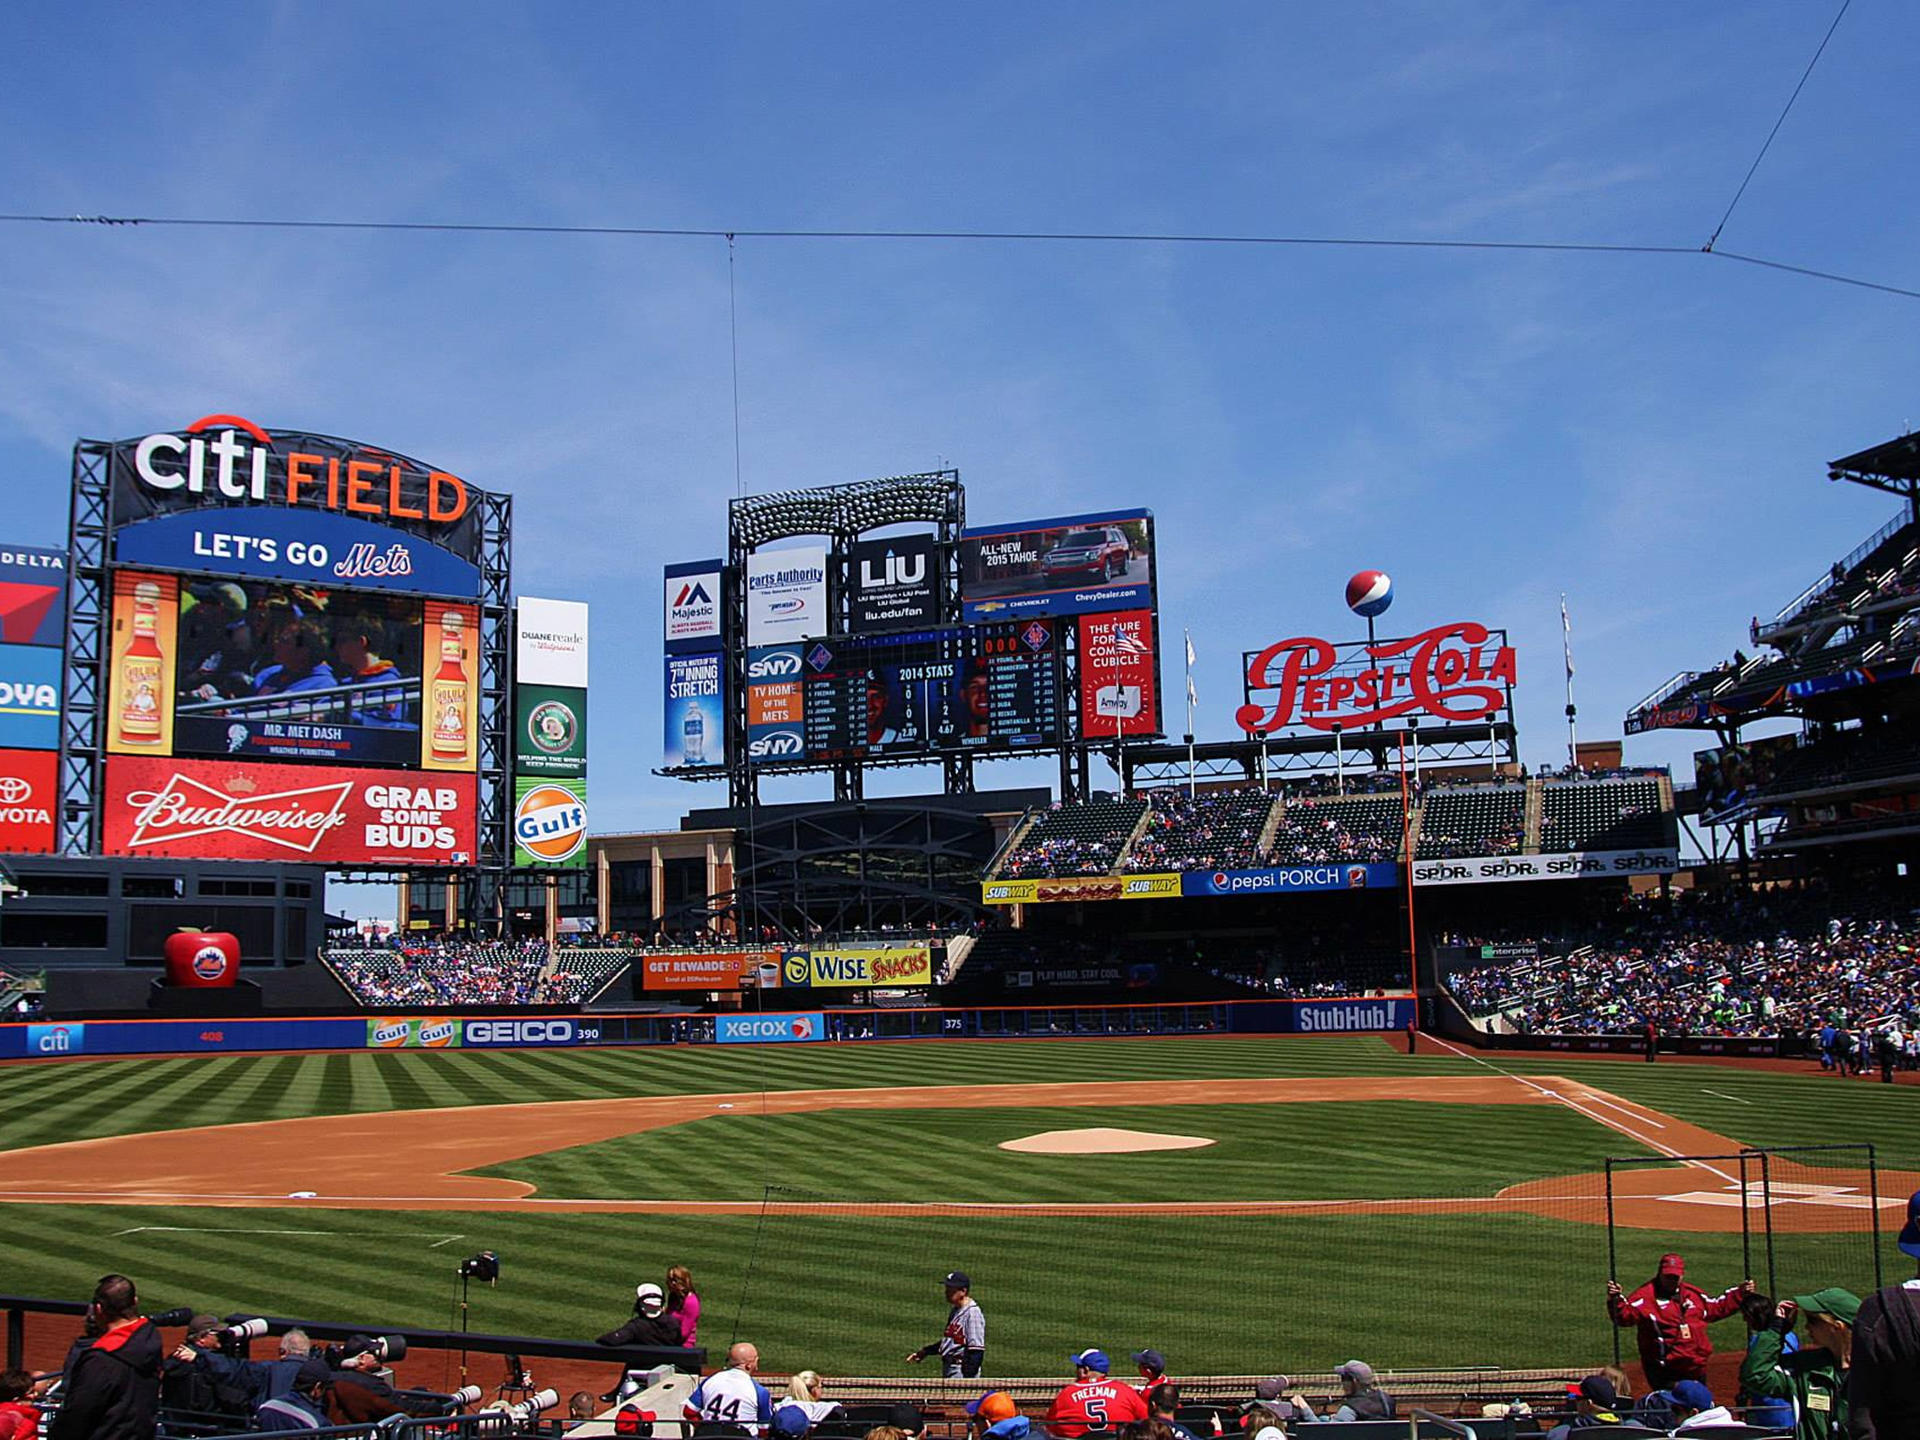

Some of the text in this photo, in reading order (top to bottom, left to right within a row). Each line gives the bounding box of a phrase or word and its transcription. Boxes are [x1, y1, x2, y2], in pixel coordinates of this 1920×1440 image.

[135, 429, 467, 522] citi FIELD
[194, 532, 413, 577] LET'S GO Mets
[981, 542, 1021, 556] ALL-NEW
[1, 552, 64, 569] DELTA
[987, 551, 1038, 566] 2015 TAHOE
[749, 567, 823, 588] Parts Authority
[869, 593, 897, 601] Brooklyn
[1075, 590, 1136, 602] ChevyDealer.com
[672, 606, 713, 619] Majestic
[865, 607, 923, 620] liu.edu/fan
[521, 631, 552, 641] DUANE
[1089, 624, 1110, 634] THE
[985, 638, 1016, 653] 0 0 0
[1093, 636, 1115, 645] FOR
[748, 656, 795, 677] SNY
[1093, 655, 1140, 667] CUBICLE
[686, 665, 718, 681] INNING
[900, 665, 953, 680] 2014 STATS
[670, 679, 718, 699] STRETCH
[754, 684, 798, 697] TV HOME
[905, 690, 912, 699] 0
[774, 698, 787, 706] THE
[943, 705, 948, 715] 2
[762, 710, 789, 722] METS
[906, 709, 912, 719] 0
[264, 724, 341, 740] MR. MET DASH
[939, 725, 954, 734] 4.67
[749, 737, 795, 756] SNY
[364, 785, 458, 811] GRAB
[127, 790, 347, 829] Budweiser
[380, 810, 442, 825] SOME
[518, 808, 581, 838] Gulf
[365, 825, 456, 849] BUDS
[1127, 877, 1178, 893] SUBWAY
[1232, 868, 1339, 890] pepsi PORCH
[986, 884, 1034, 899] SUBWAY
[649, 962, 670, 972] GET
[814, 951, 929, 984] WISE SNACKS
[1300, 1000, 1396, 1031] StubHub!
[466, 1021, 572, 1042] GEICO
[726, 1020, 787, 1037] xerox
[945, 1019, 962, 1029] 375
[40, 1030, 69, 1051] citi
[376, 1025, 408, 1041] Gulf
[420, 1025, 452, 1041] Gulf
[577, 1029, 599, 1039] 390
[1071, 1386, 1117, 1402] FREEMAN
[707, 1393, 740, 1420] 44
[1085, 1399, 1108, 1431] 5
